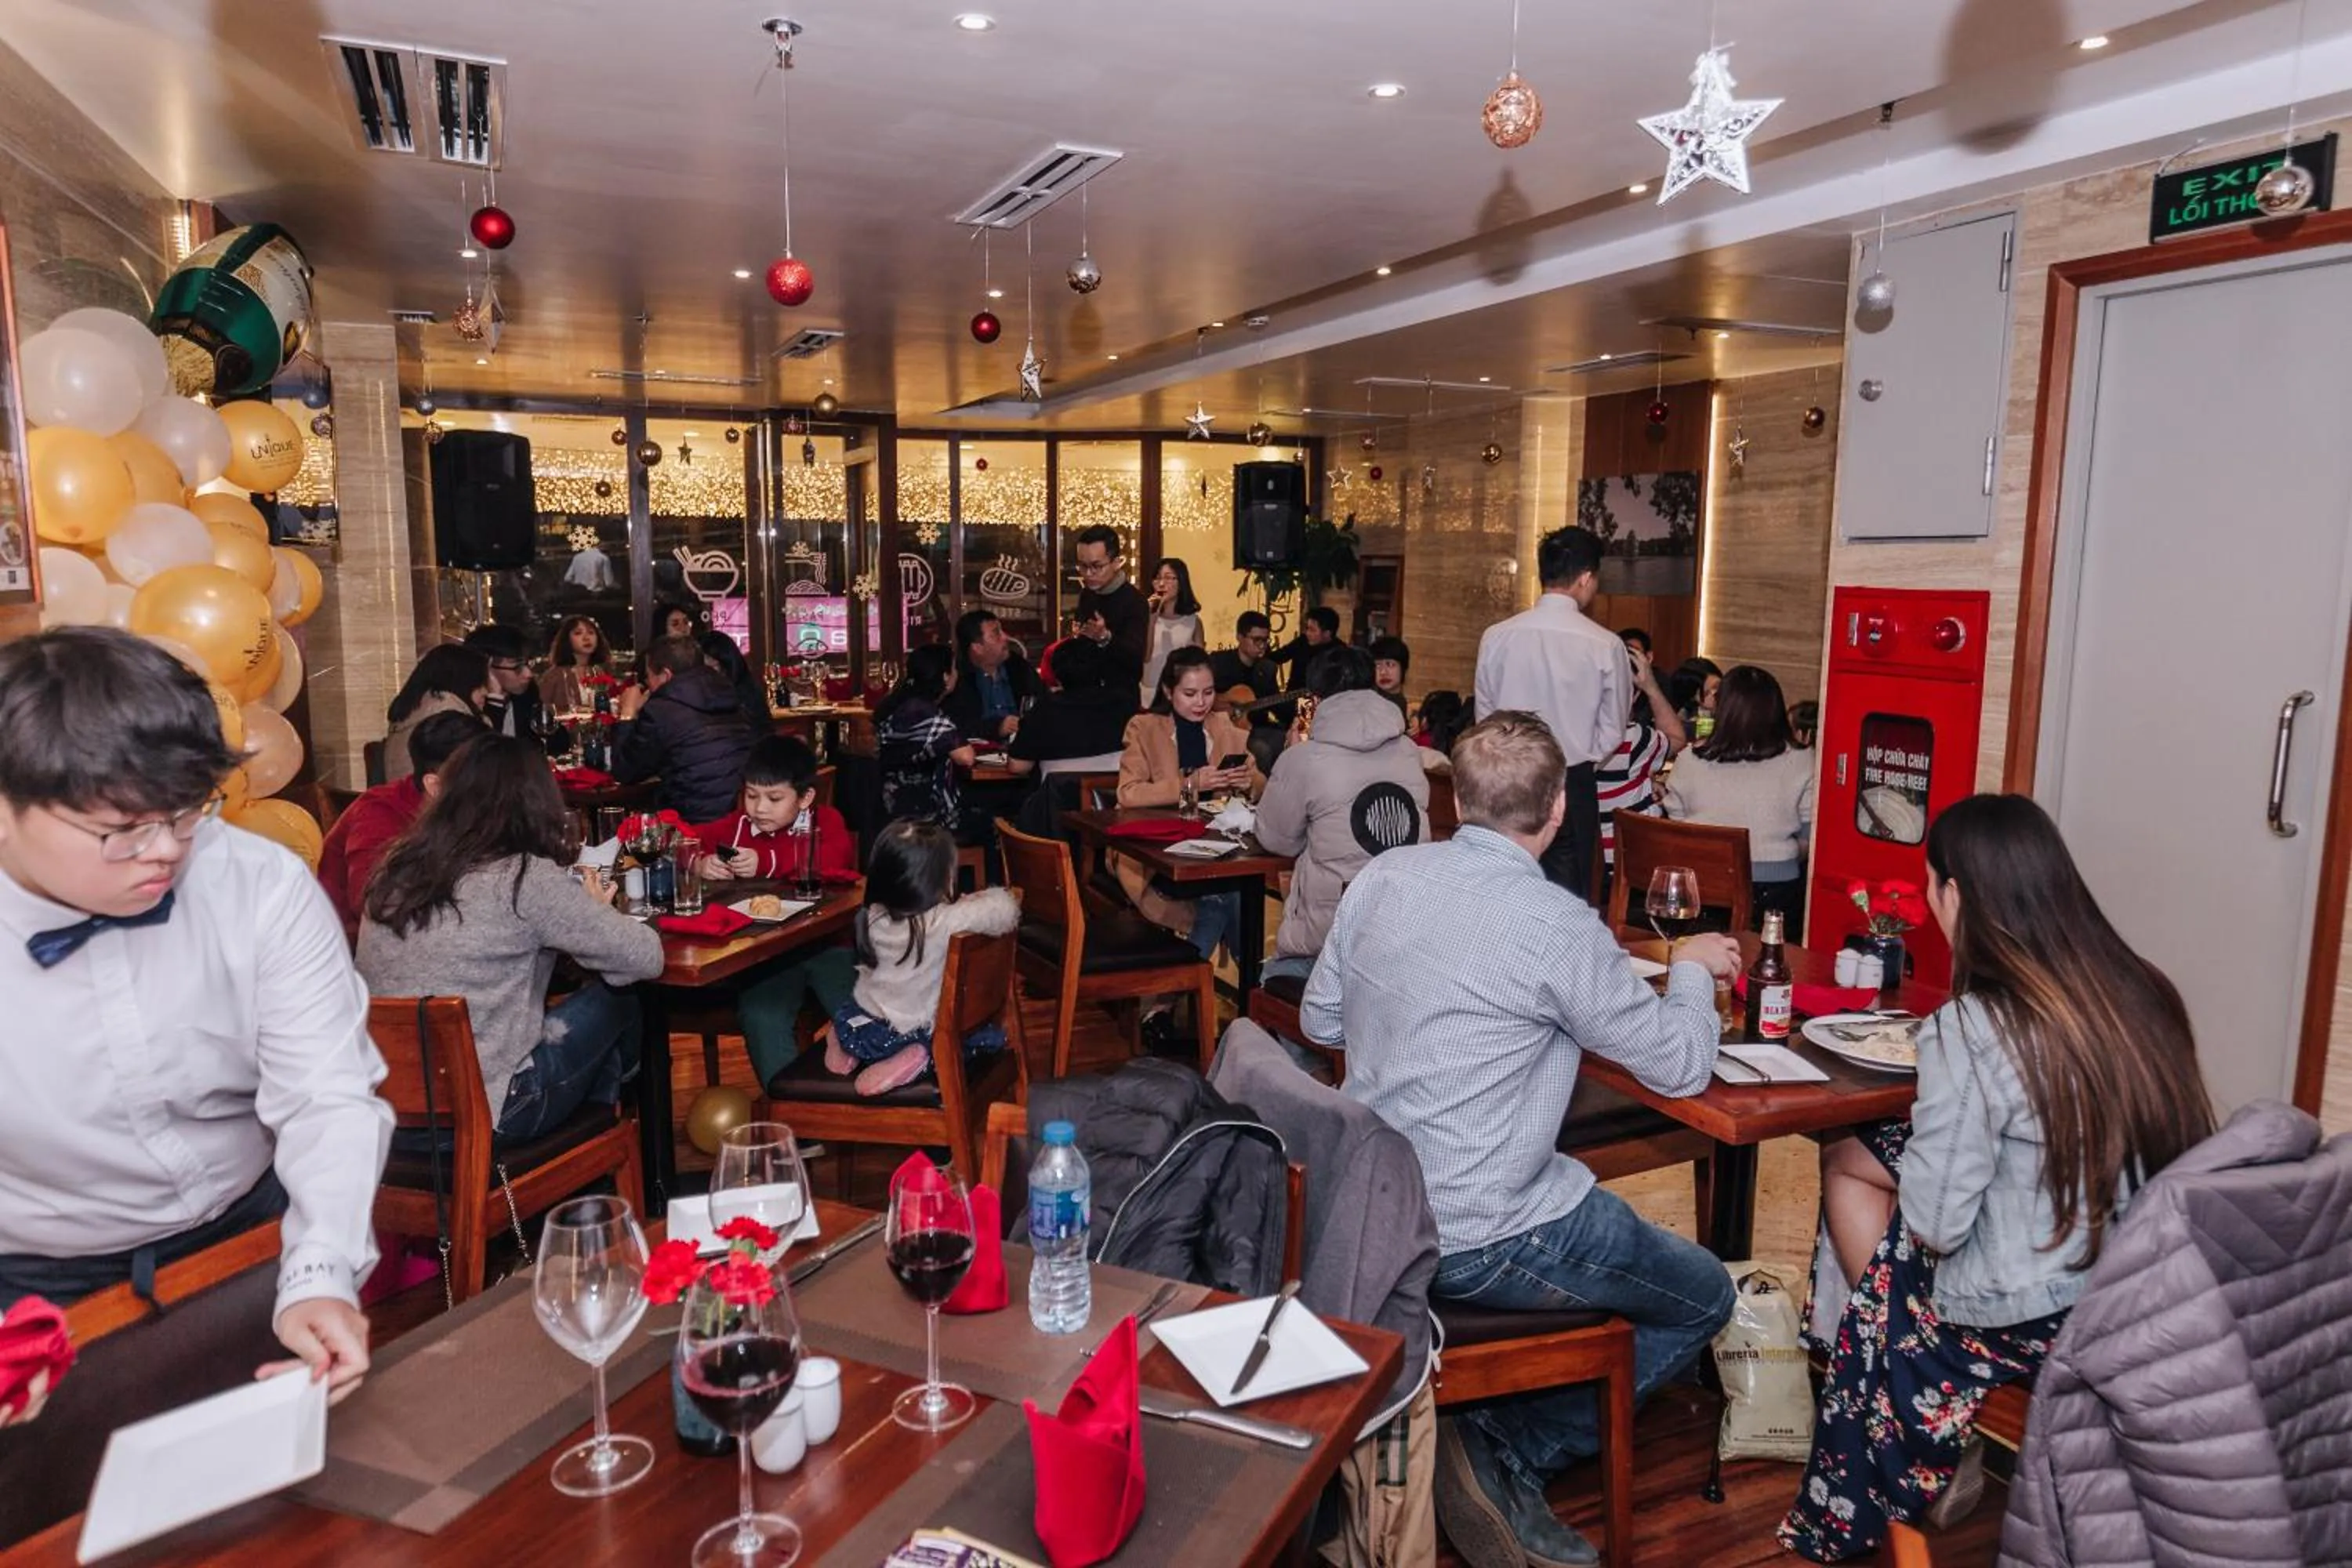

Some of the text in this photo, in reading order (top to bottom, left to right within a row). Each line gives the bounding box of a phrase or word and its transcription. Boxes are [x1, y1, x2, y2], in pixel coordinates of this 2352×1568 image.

[2169, 194, 2209, 226] LỐI
[1865, 767, 1883, 783] FIRE
[1884, 771, 1907, 787] HOSE
